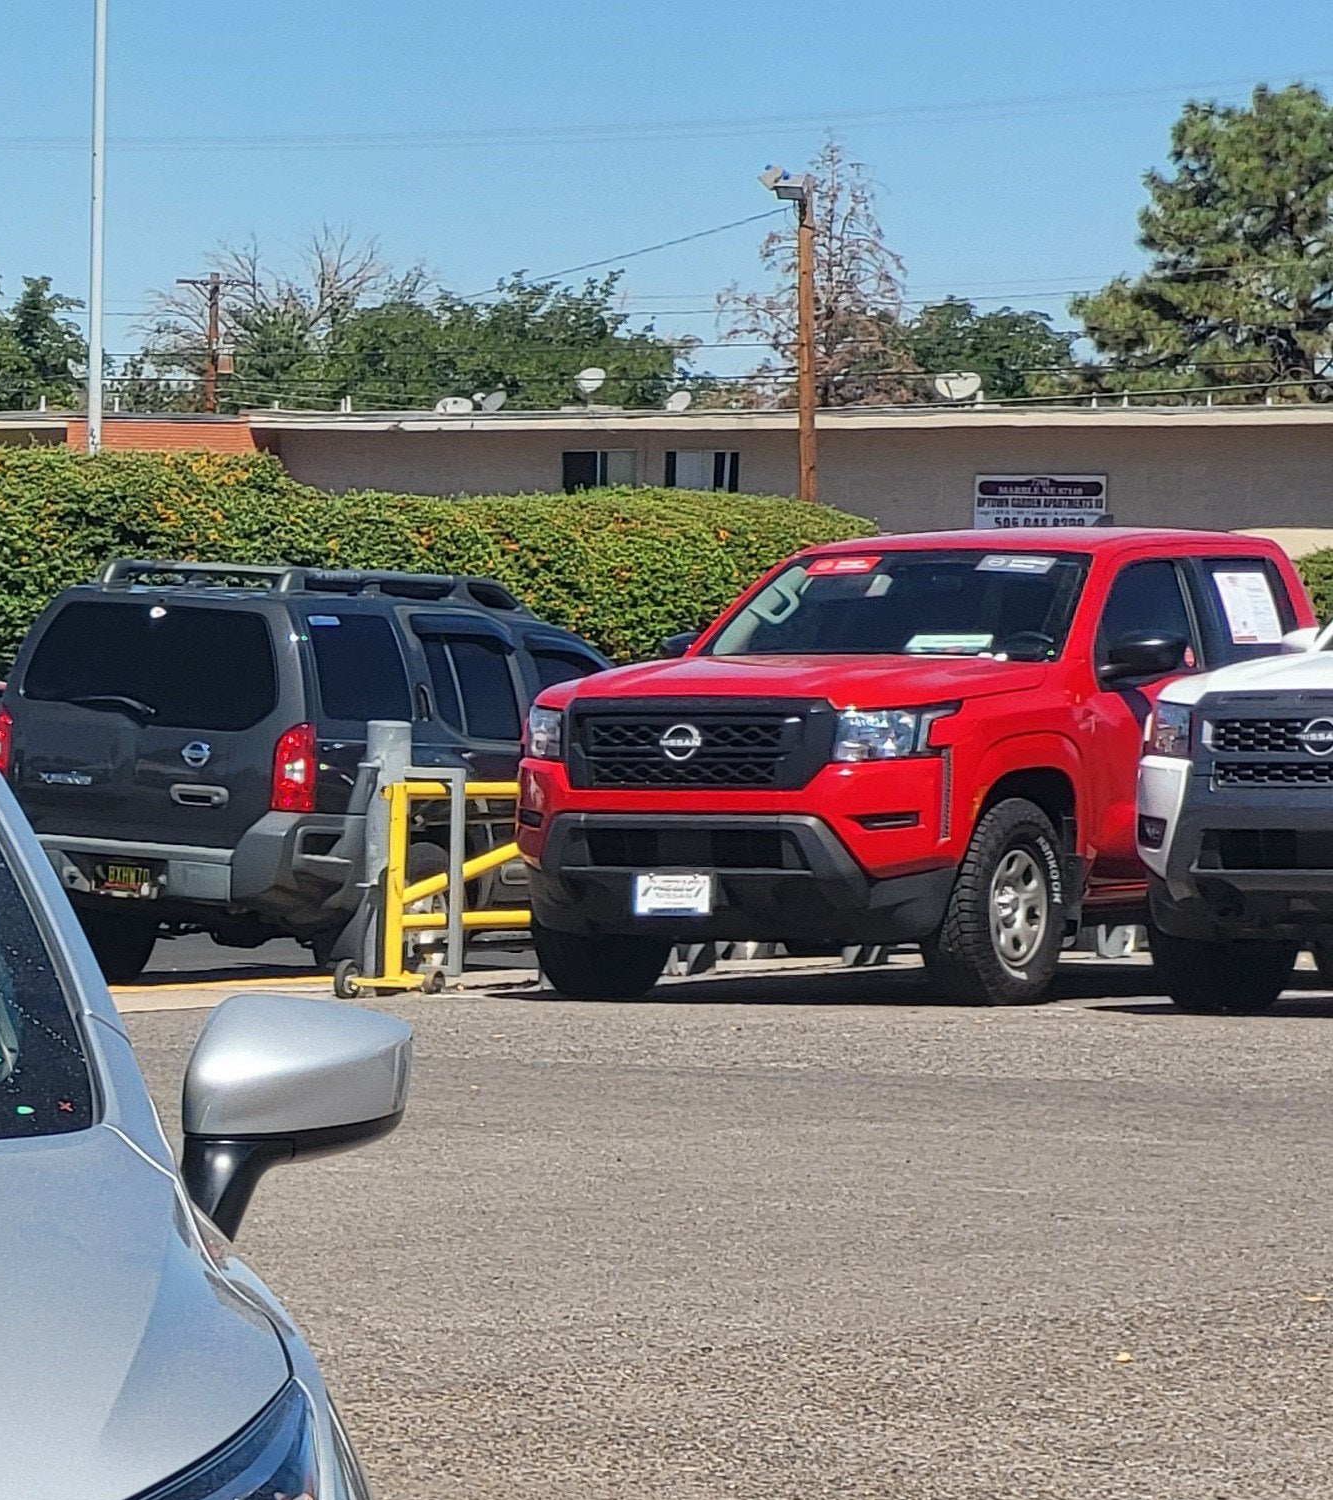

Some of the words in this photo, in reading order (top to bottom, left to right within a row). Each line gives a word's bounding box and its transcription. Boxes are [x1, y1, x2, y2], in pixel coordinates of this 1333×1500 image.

[998, 486, 1040, 495] MARBLE
[660, 736, 701, 746] NISSAN
[1296, 732, 1333, 741] NISSA
